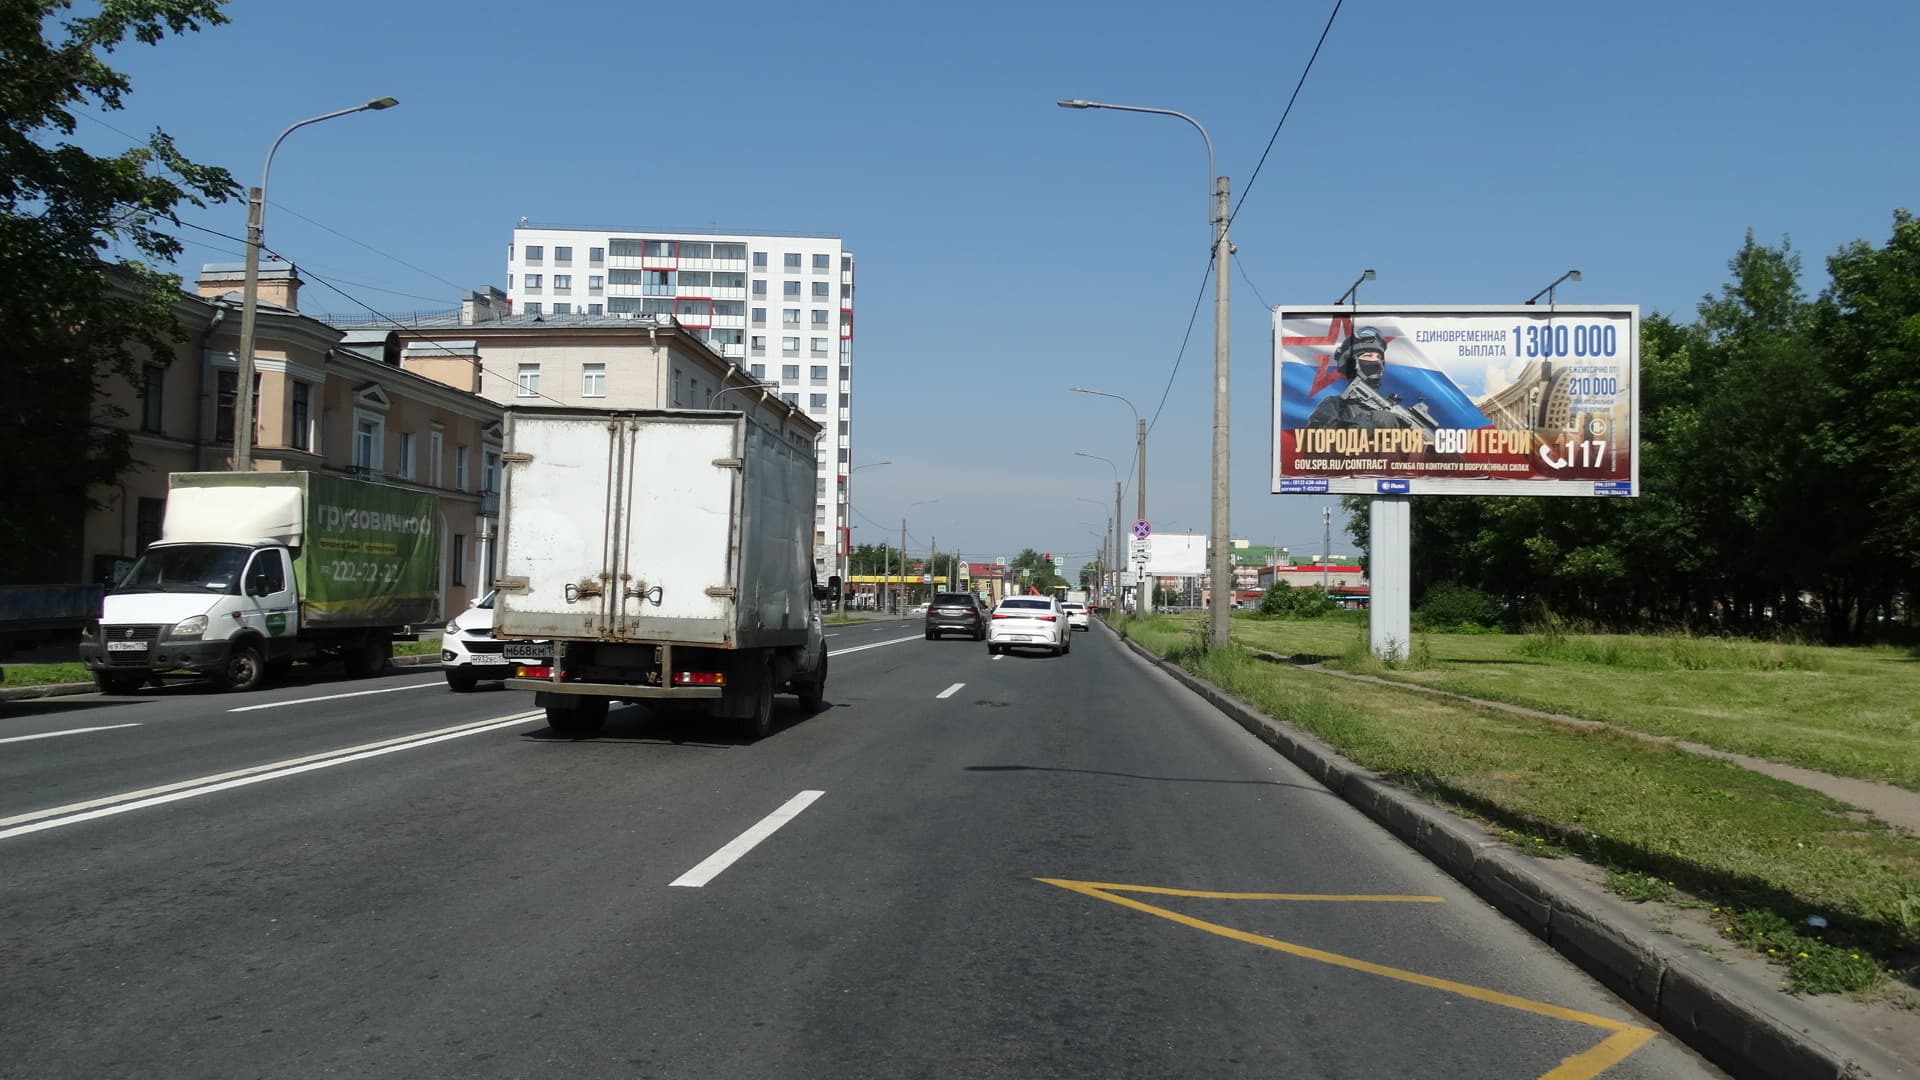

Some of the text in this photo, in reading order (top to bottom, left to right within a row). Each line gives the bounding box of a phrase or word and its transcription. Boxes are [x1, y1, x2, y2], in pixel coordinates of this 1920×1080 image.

[1416, 330, 1506, 343] ЕДИНОВРЕМЕННАЯ
[1458, 344, 1506, 357] ВЫПЛАТА
[1569, 377, 1617, 396] 210 000
[1294, 428, 1305, 453] У
[1307, 428, 1422, 456] ГОРОДА-ГЕРОЯ
[1434, 428, 1478, 454] СВОИ
[1565, 440, 1606, 468] 117
[1294, 459, 1388, 470] GOV.SPB.RU/CONTRACT
[1390, 462, 1416, 470] СЛУЖБА
[1425, 462, 1458, 470] КОНТРАКТУ
